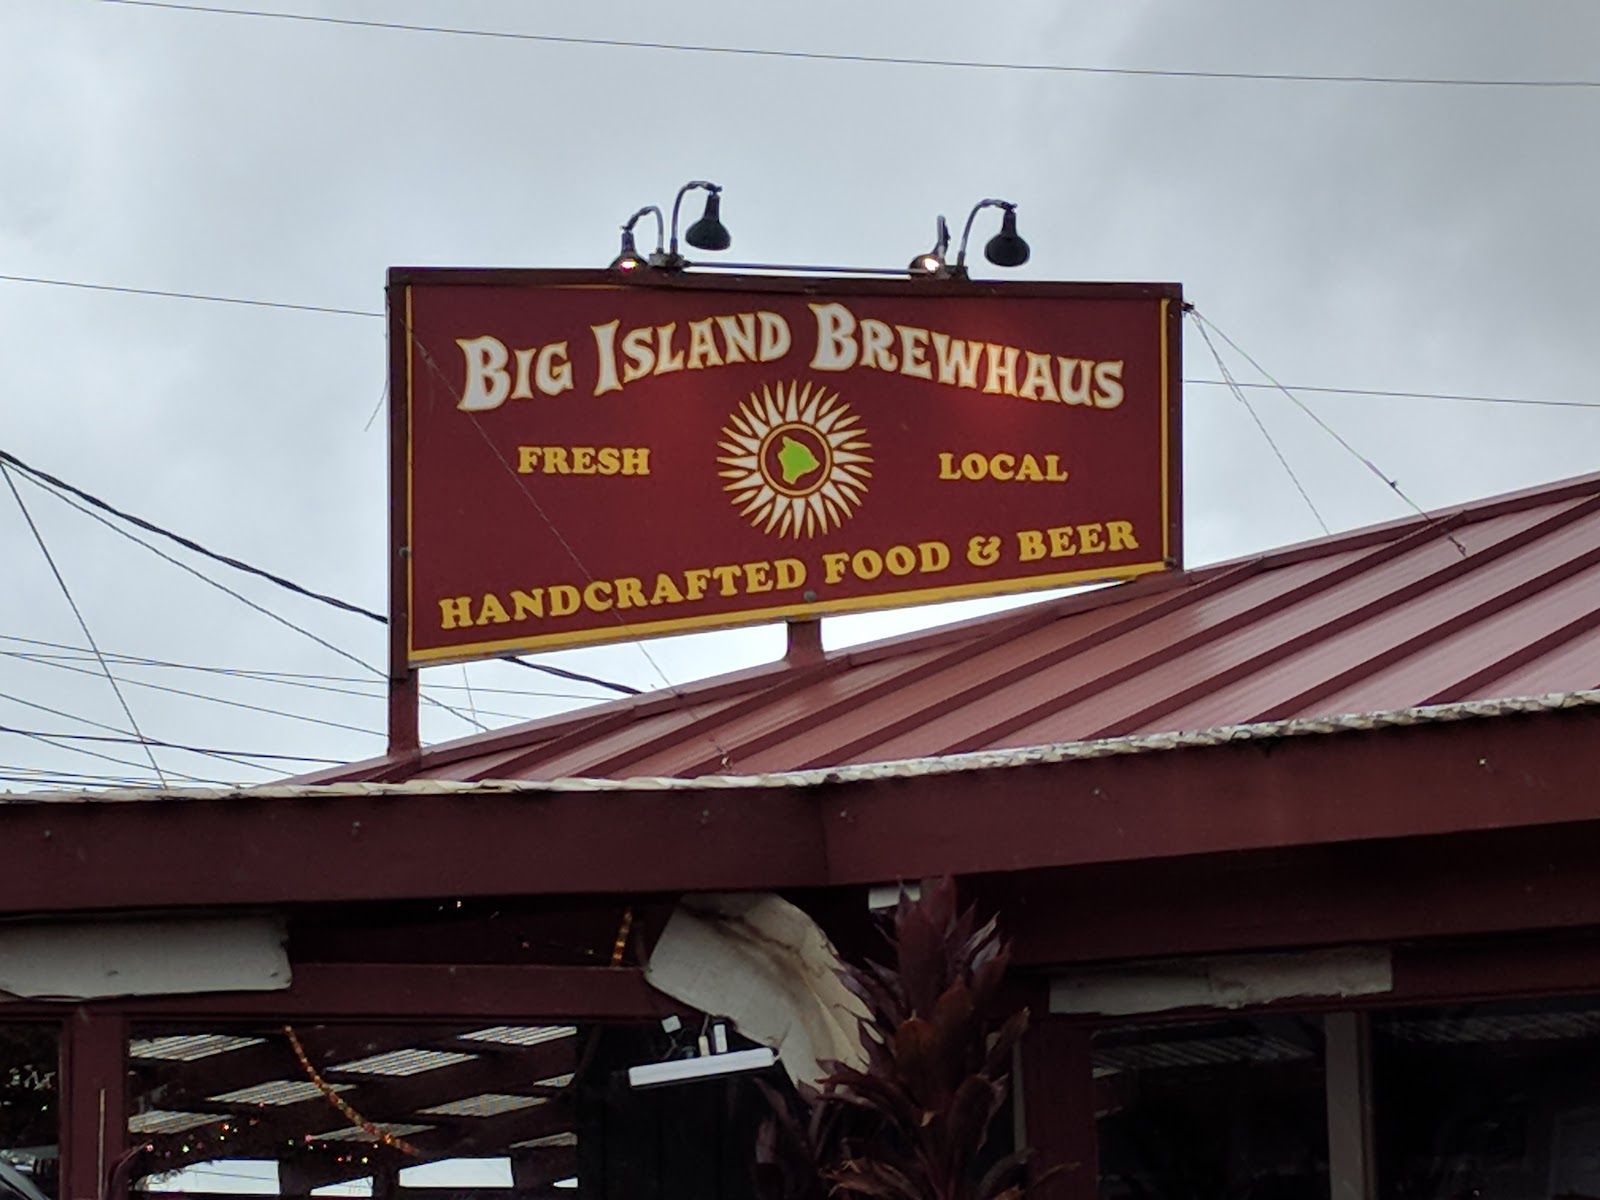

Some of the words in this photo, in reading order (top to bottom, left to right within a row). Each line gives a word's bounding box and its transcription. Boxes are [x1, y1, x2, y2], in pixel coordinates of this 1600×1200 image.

[456, 336, 573, 410] BIG
[591, 312, 790, 395] ISLAND
[806, 303, 1123, 409] BREWHAUS
[518, 447, 649, 474] FRESH
[939, 453, 1067, 481] LOCAL
[439, 559, 806, 629] HANDCRAFTED
[823, 542, 949, 583] FOOD
[968, 537, 1000, 565] &
[1017, 521, 1138, 560] BEER
